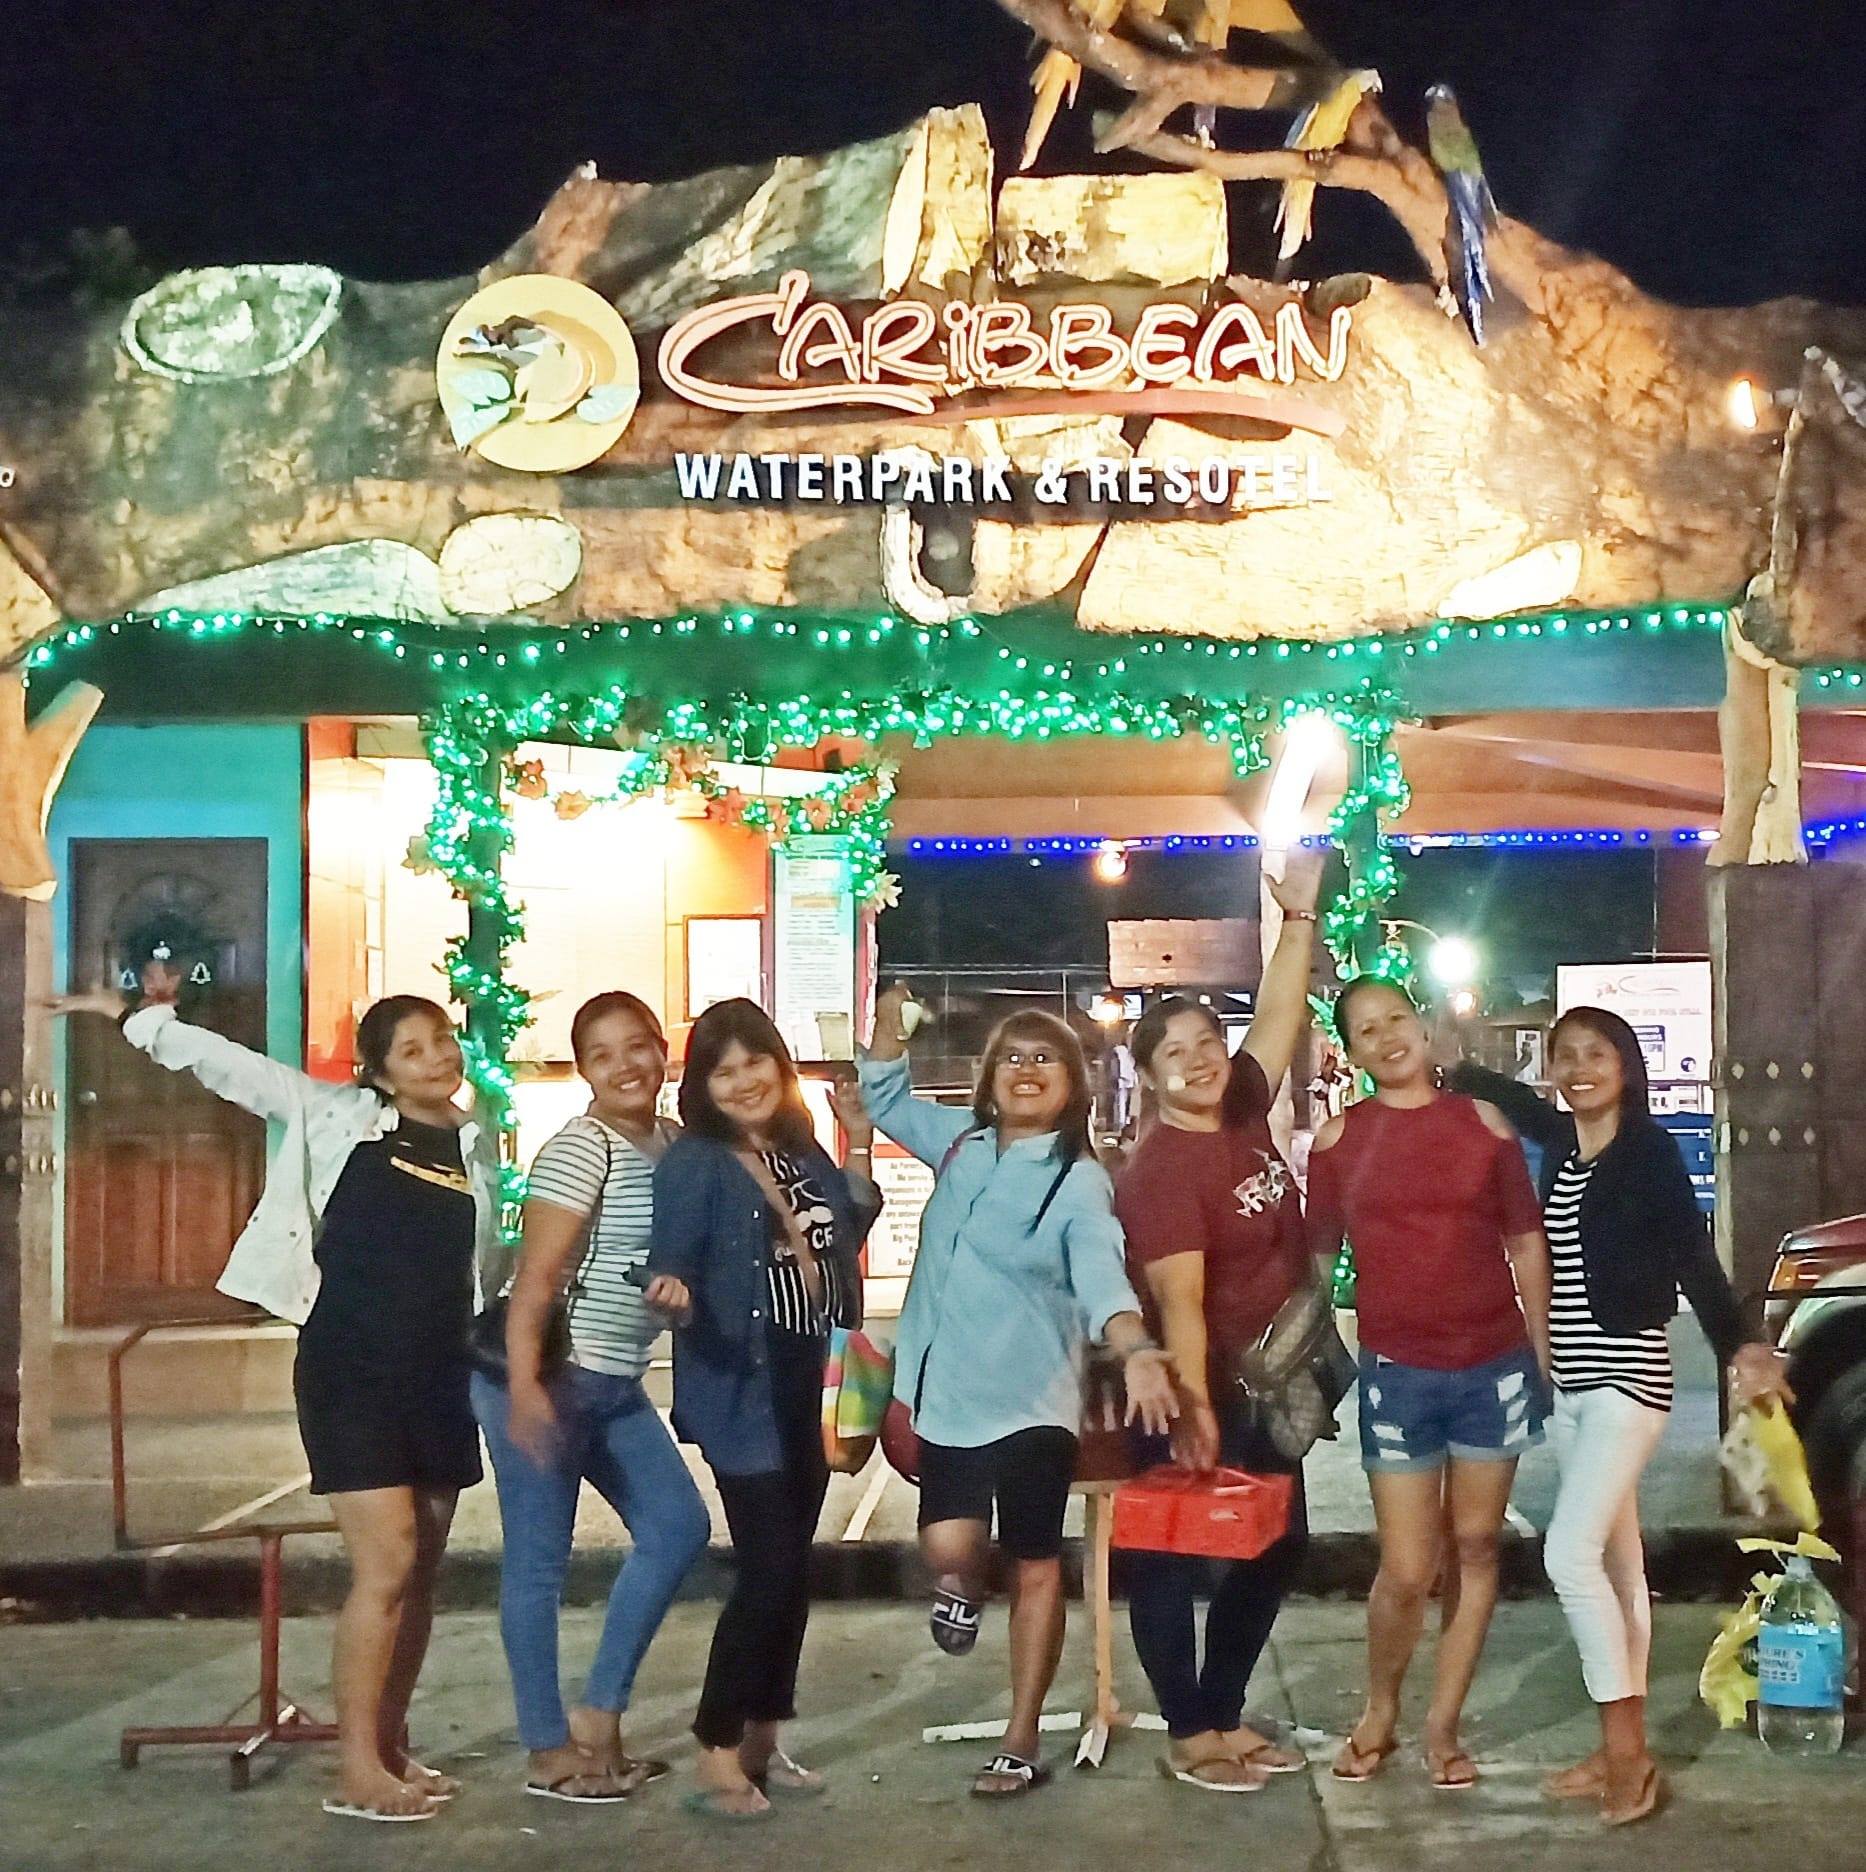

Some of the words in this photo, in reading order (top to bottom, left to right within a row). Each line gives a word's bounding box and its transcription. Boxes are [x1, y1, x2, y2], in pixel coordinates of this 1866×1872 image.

[674, 452, 1012, 505] WATERPARK
[1034, 455, 1068, 504] &
[1089, 455, 1333, 505] RESOTEL
